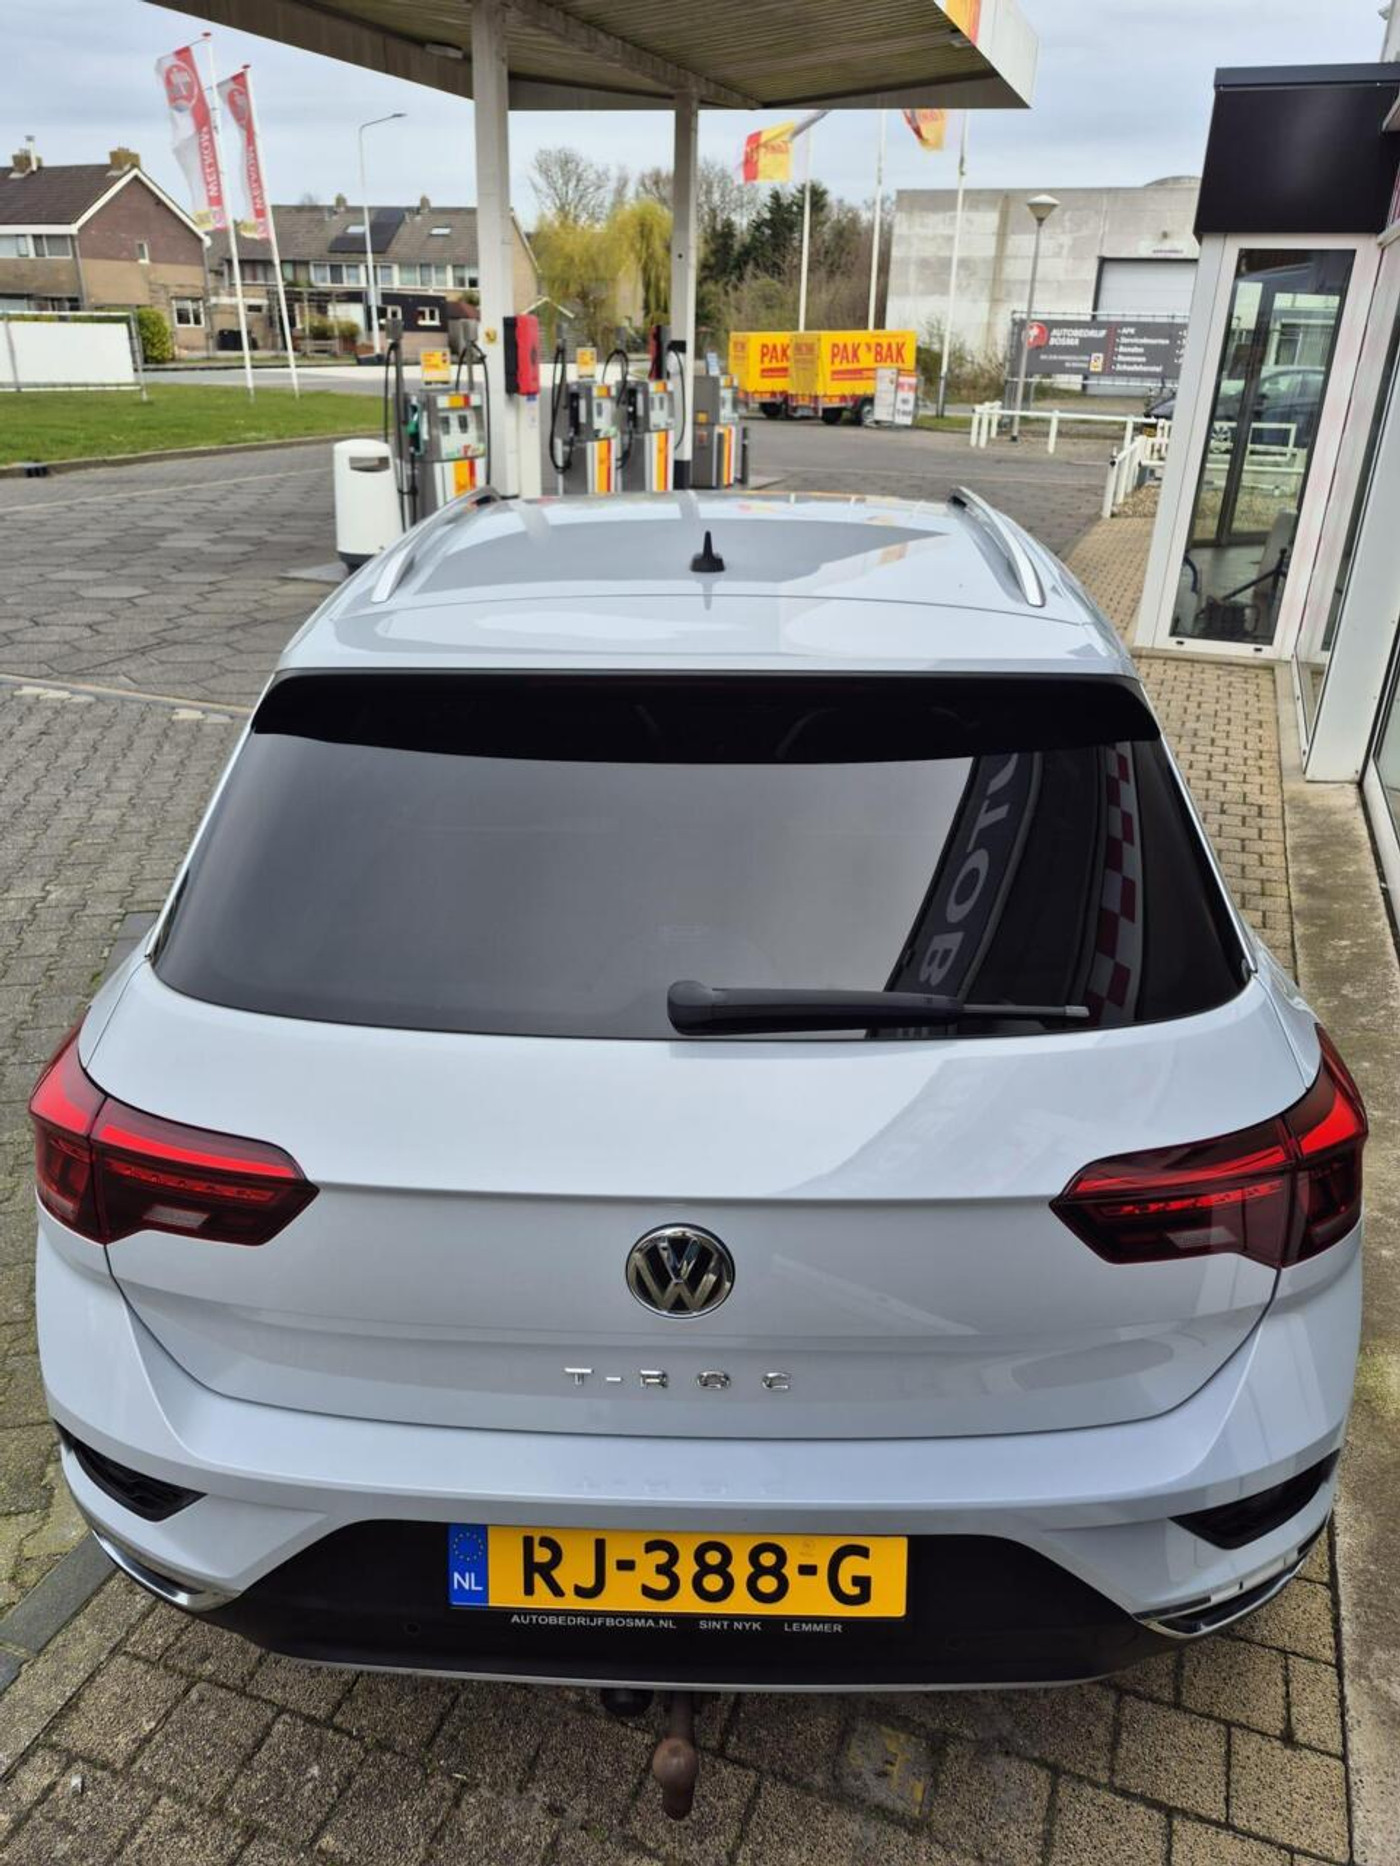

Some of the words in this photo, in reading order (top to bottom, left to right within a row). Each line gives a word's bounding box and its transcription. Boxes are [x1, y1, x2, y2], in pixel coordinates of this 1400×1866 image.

[831, 342, 861, 364] PAK
[874, 341, 906, 364] BAK
[1048, 337, 1079, 346] BOSMA
[760, 343, 790, 364] PAK
[564, 1366, 793, 1391] T-ROC
[452, 1571, 484, 1591] NL
[522, 1534, 872, 1607] RJ-388-G
[510, 1614, 677, 1630] AUTOBEDRIJFBOSMA.NL
[699, 1619, 728, 1631] SINT
[733, 1620, 762, 1631] NYK
[784, 1622, 843, 1634] LEMMER
